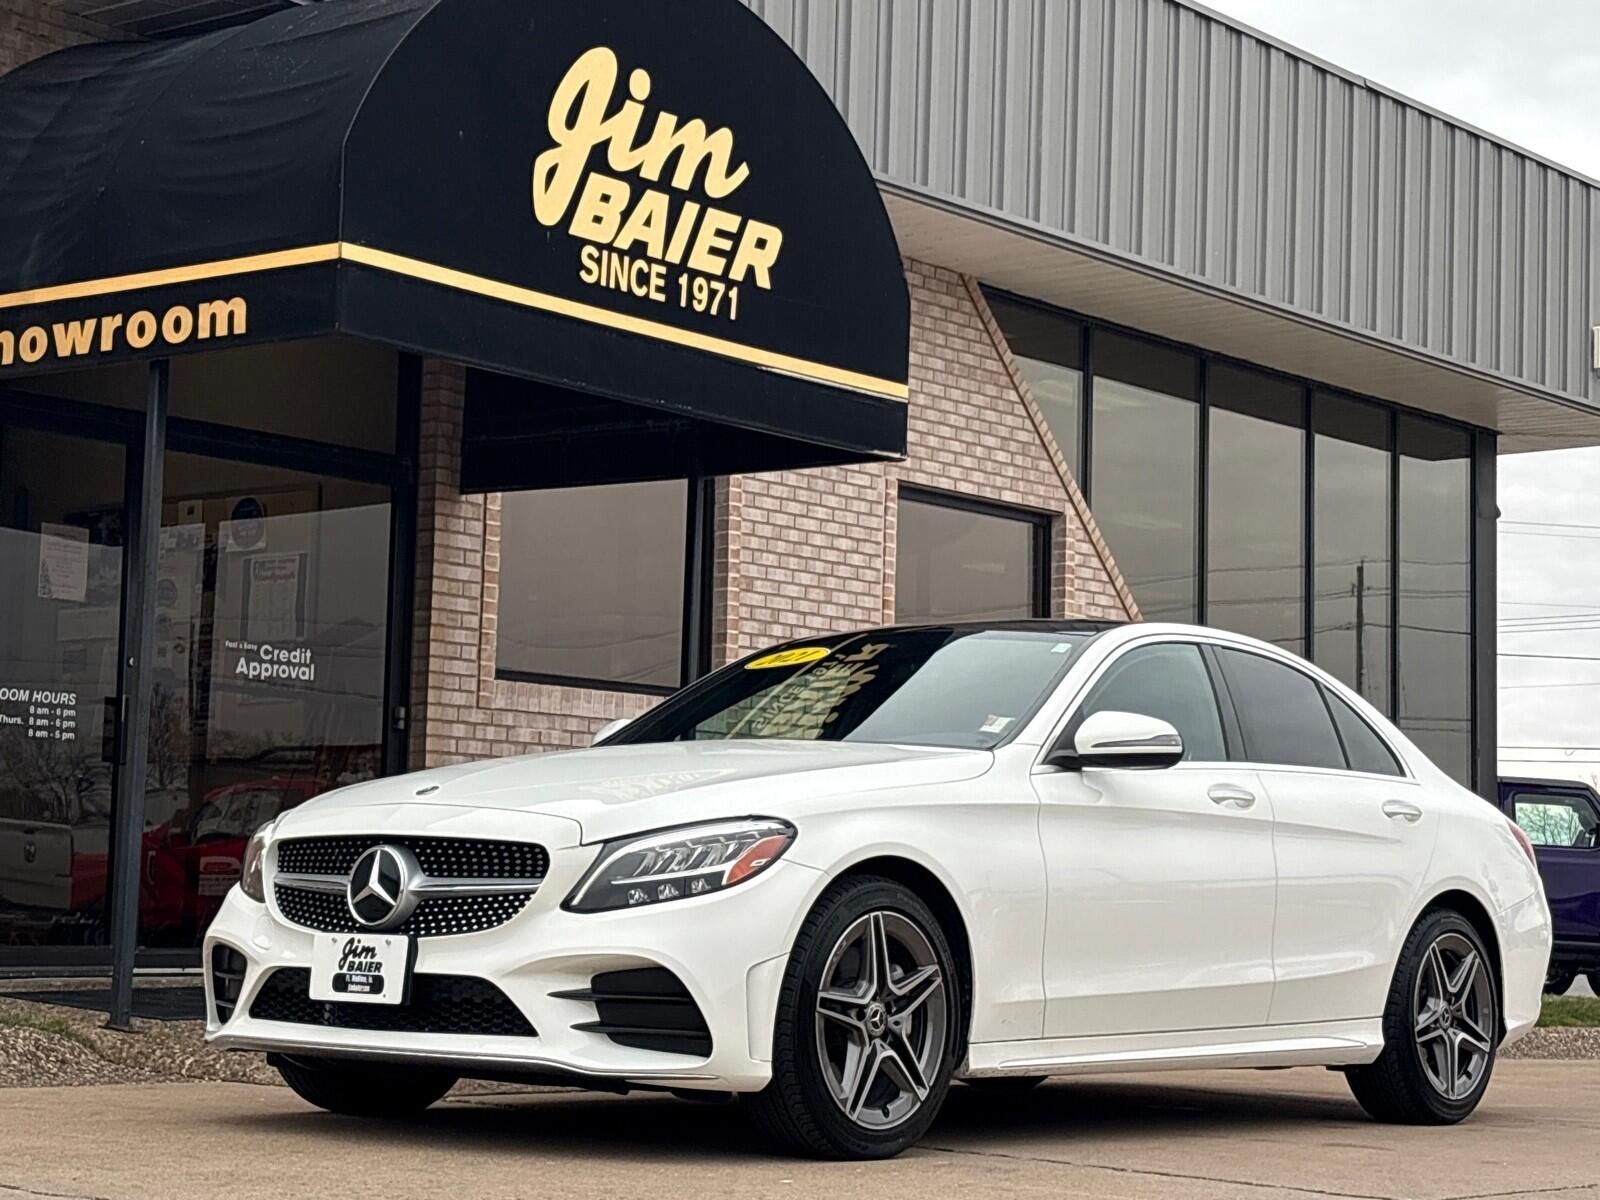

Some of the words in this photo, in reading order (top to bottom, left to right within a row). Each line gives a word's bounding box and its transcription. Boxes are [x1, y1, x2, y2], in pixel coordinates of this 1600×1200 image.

[533, 46, 750, 226] Jim
[568, 171, 783, 290] BAIER
[579, 245, 667, 302] SINCE
[678, 272, 739, 320] 1971
[260, 644, 311, 664] Credit
[235, 657, 315, 681] Approval
[32, 690, 77, 705] HOURS
[29, 716, 34, 725] 8
[56, 718, 61, 727] 6
[62, 720, 76, 729] pm
[36, 707, 49, 715] am
[63, 709, 76, 718] pm
[55, 730, 60, 739] 5
[62, 732, 75, 741] pm
[338, 937, 377, 971] Jim
[346, 960, 383, 973] BAIER
